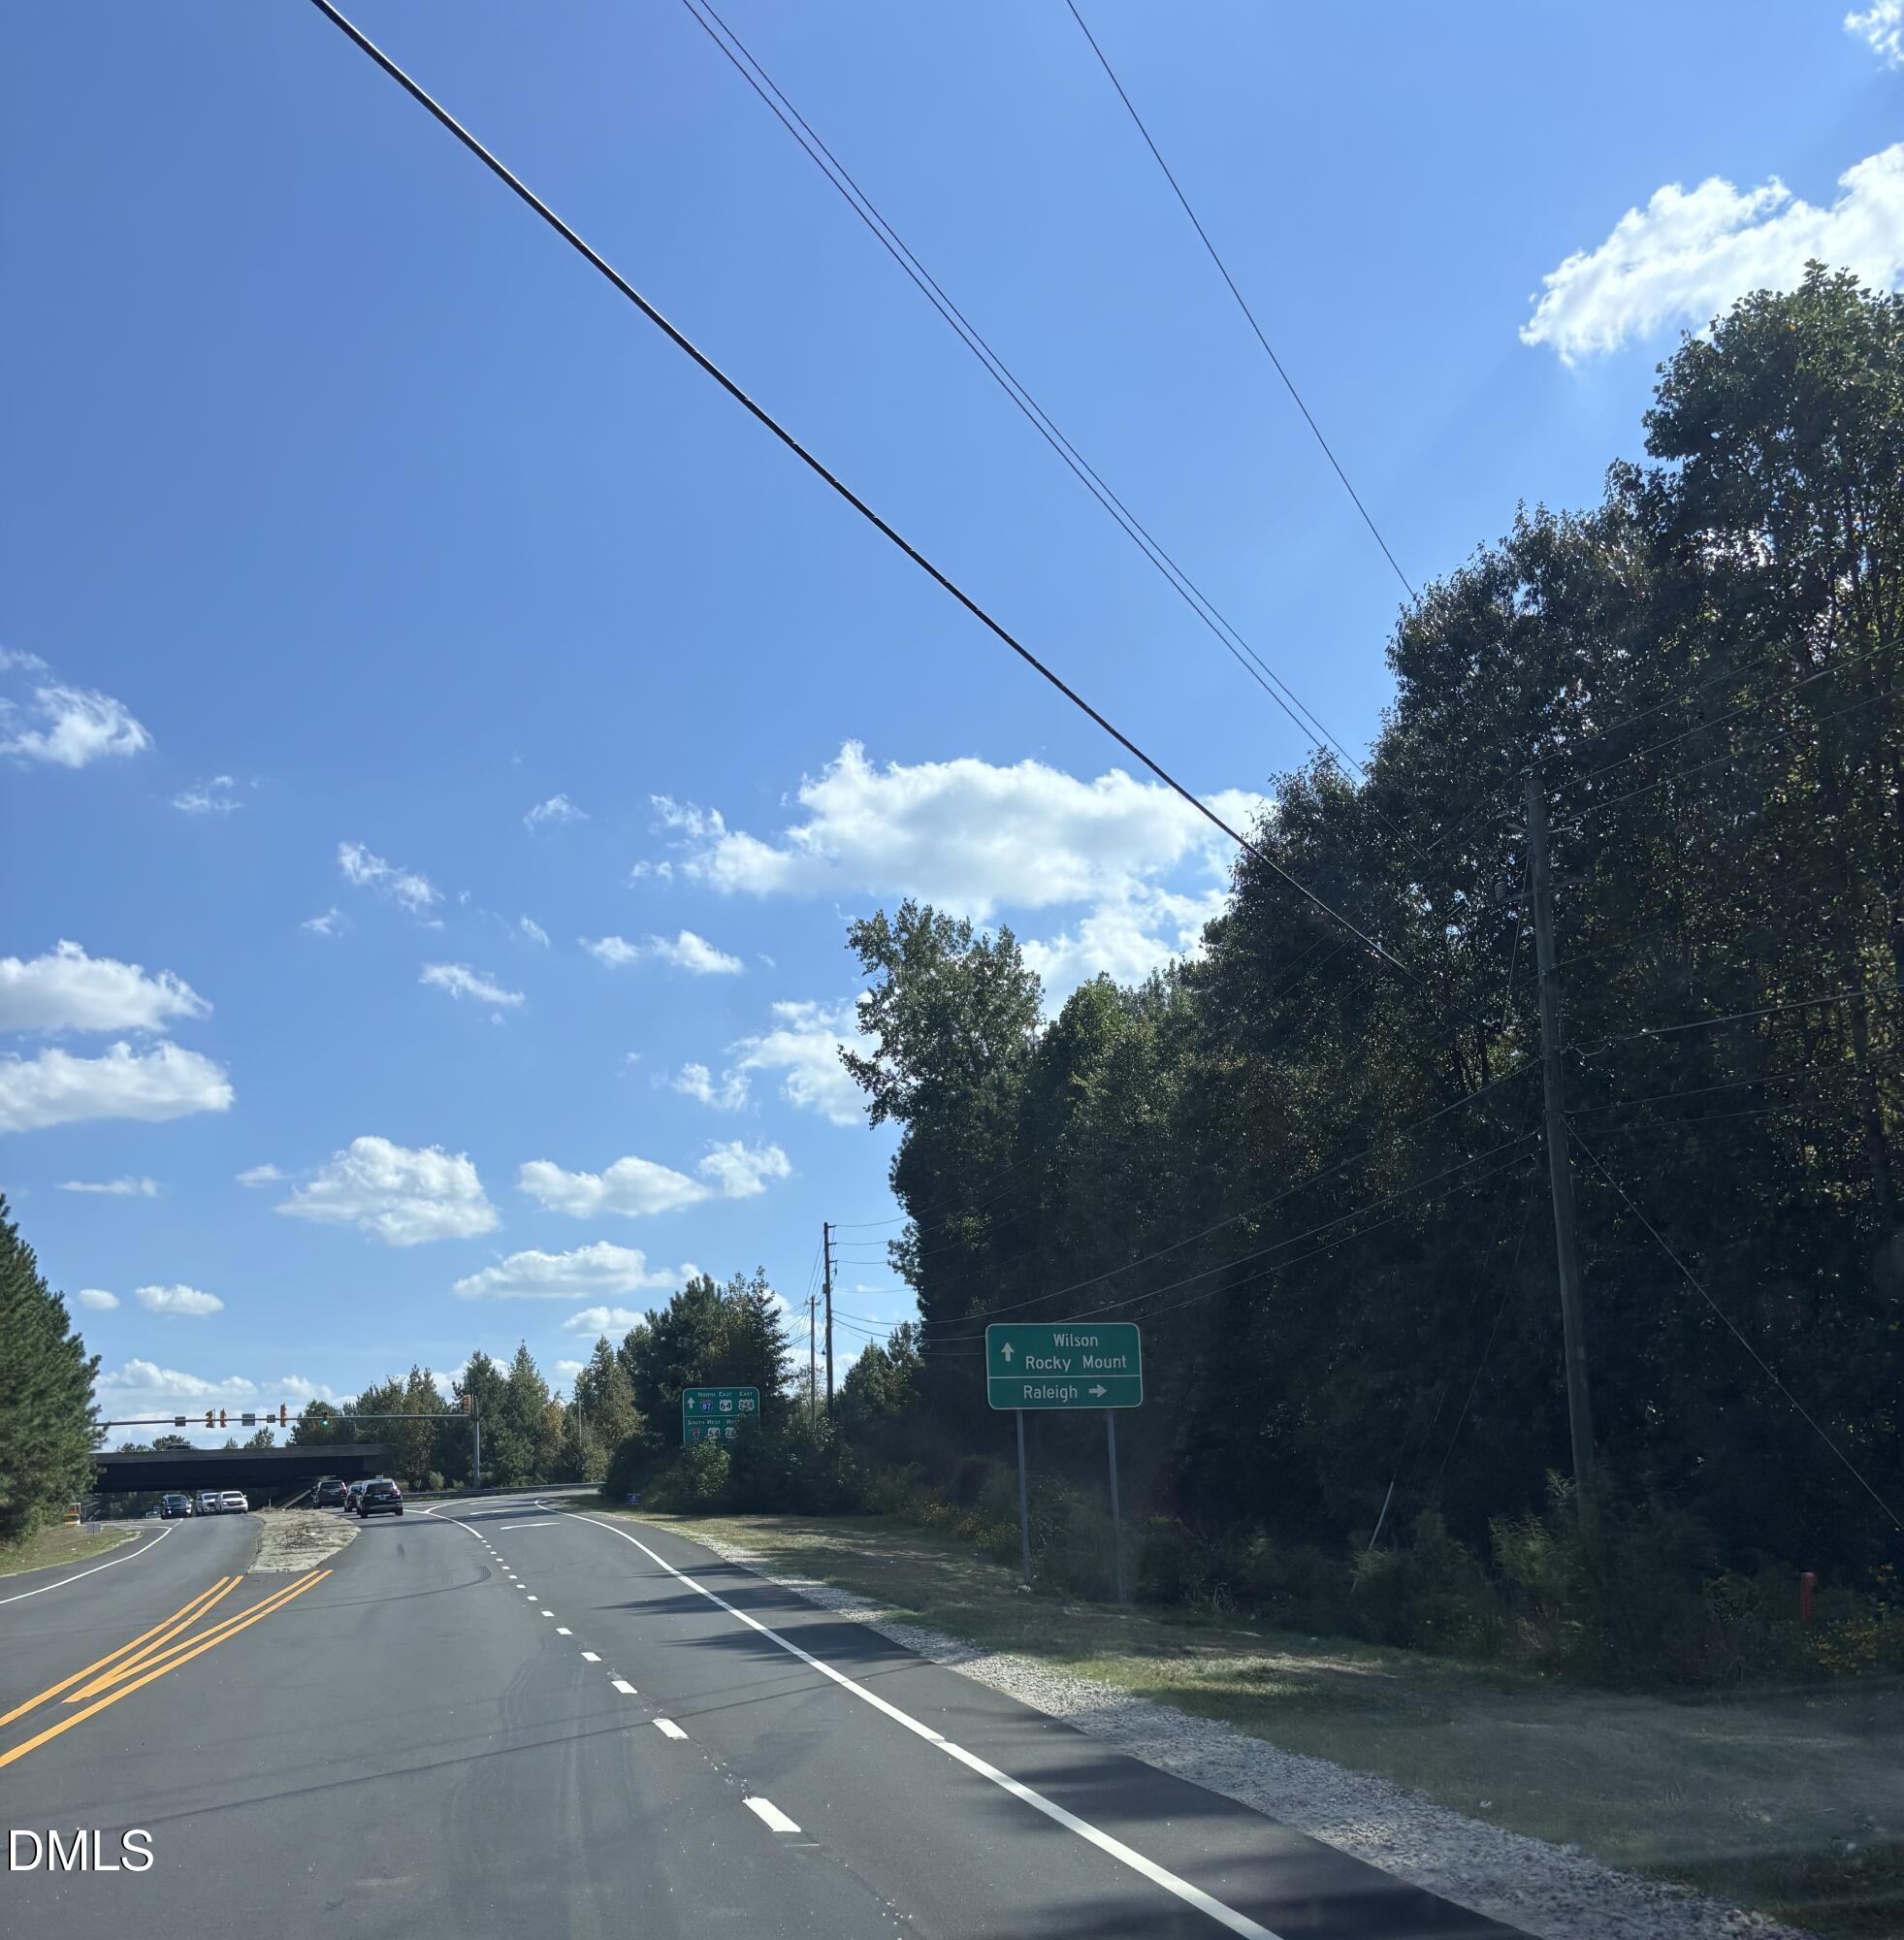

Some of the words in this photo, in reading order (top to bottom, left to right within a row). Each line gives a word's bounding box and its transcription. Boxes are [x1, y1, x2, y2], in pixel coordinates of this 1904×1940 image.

[1053, 1333, 1099, 1347] Wilson
[1025, 1355, 1072, 1373] Rocky
[1082, 1355, 1127, 1369] Mount
[1023, 1384, 1078, 1403] Raleigh
